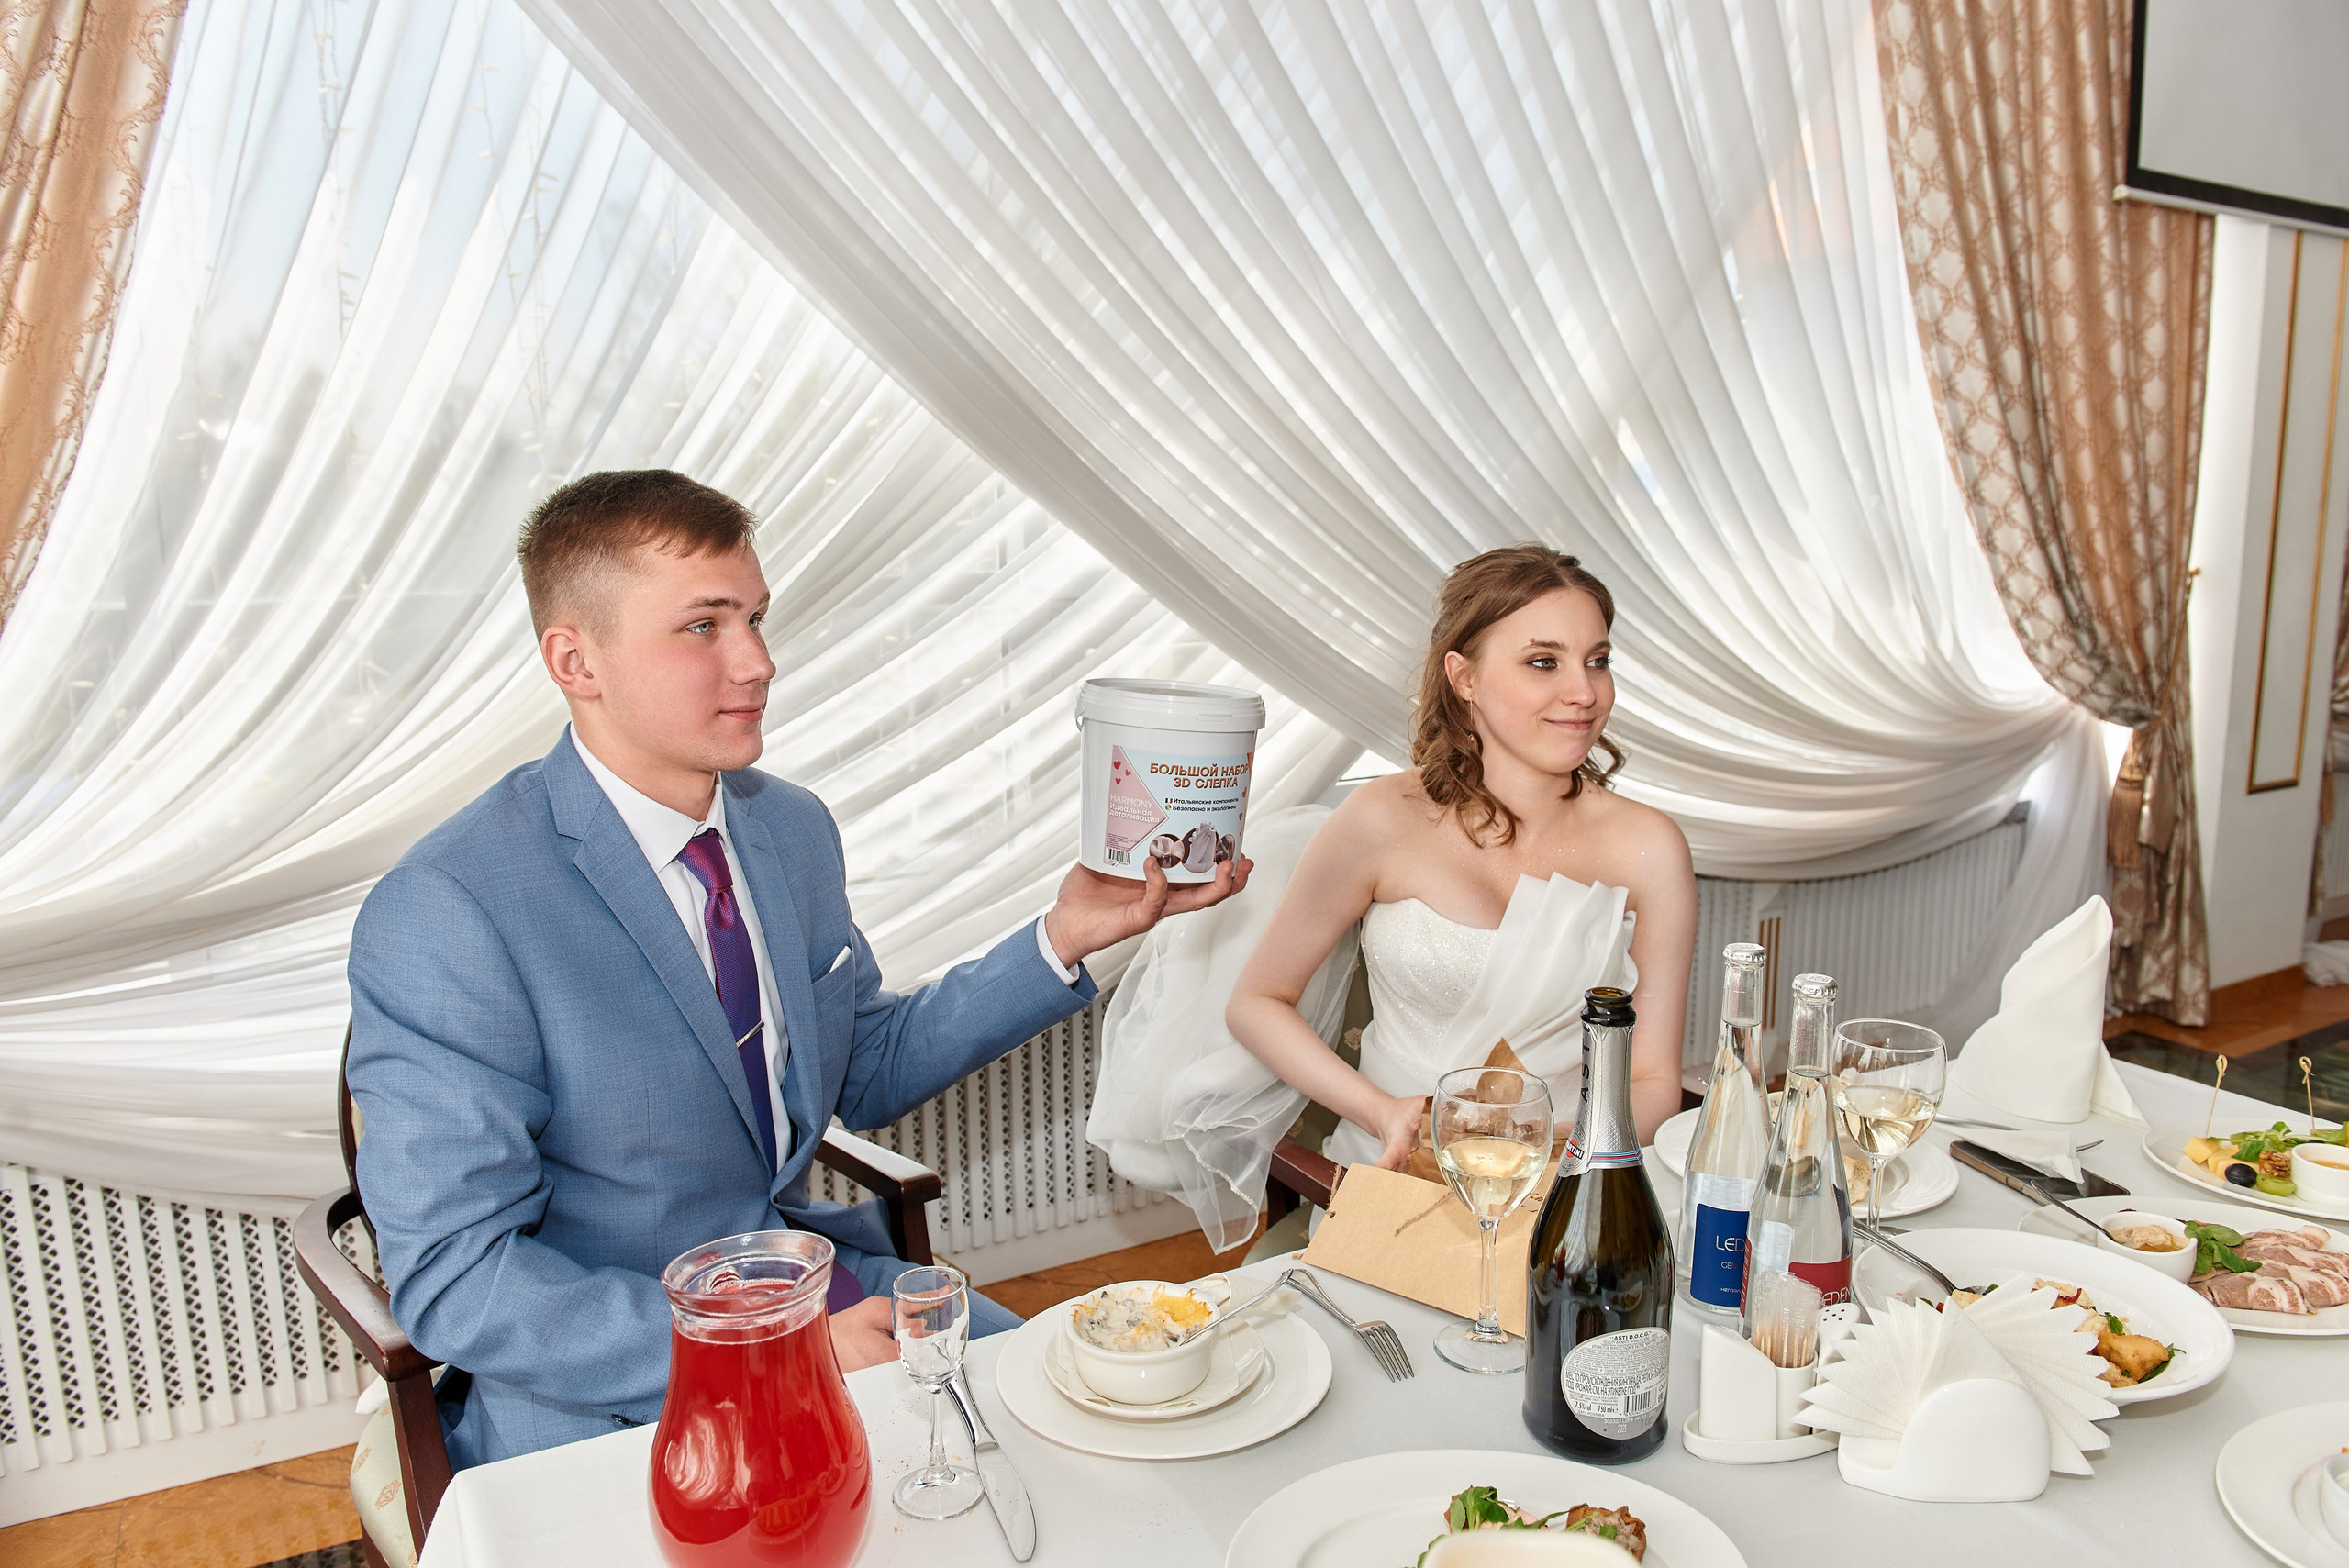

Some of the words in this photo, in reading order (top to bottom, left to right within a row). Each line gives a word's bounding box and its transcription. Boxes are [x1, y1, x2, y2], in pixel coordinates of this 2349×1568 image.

[1150, 762, 1219, 777] БОЛЬШОЙ
[1221, 763, 1249, 777] НАБОР
[1173, 777, 1191, 788] 3D
[1195, 777, 1238, 789] СЛЕПКА
[1110, 794, 1153, 808] HARMONY
[1108, 809, 1160, 823] детализация
[1109, 802, 1152, 817] Идеальная
[1565, 1140, 1584, 1159] ARTINI
[1715, 1235, 1746, 1252] LED
[1821, 1286, 1851, 1306] EDEN
[1598, 1405, 1606, 1413] 750
